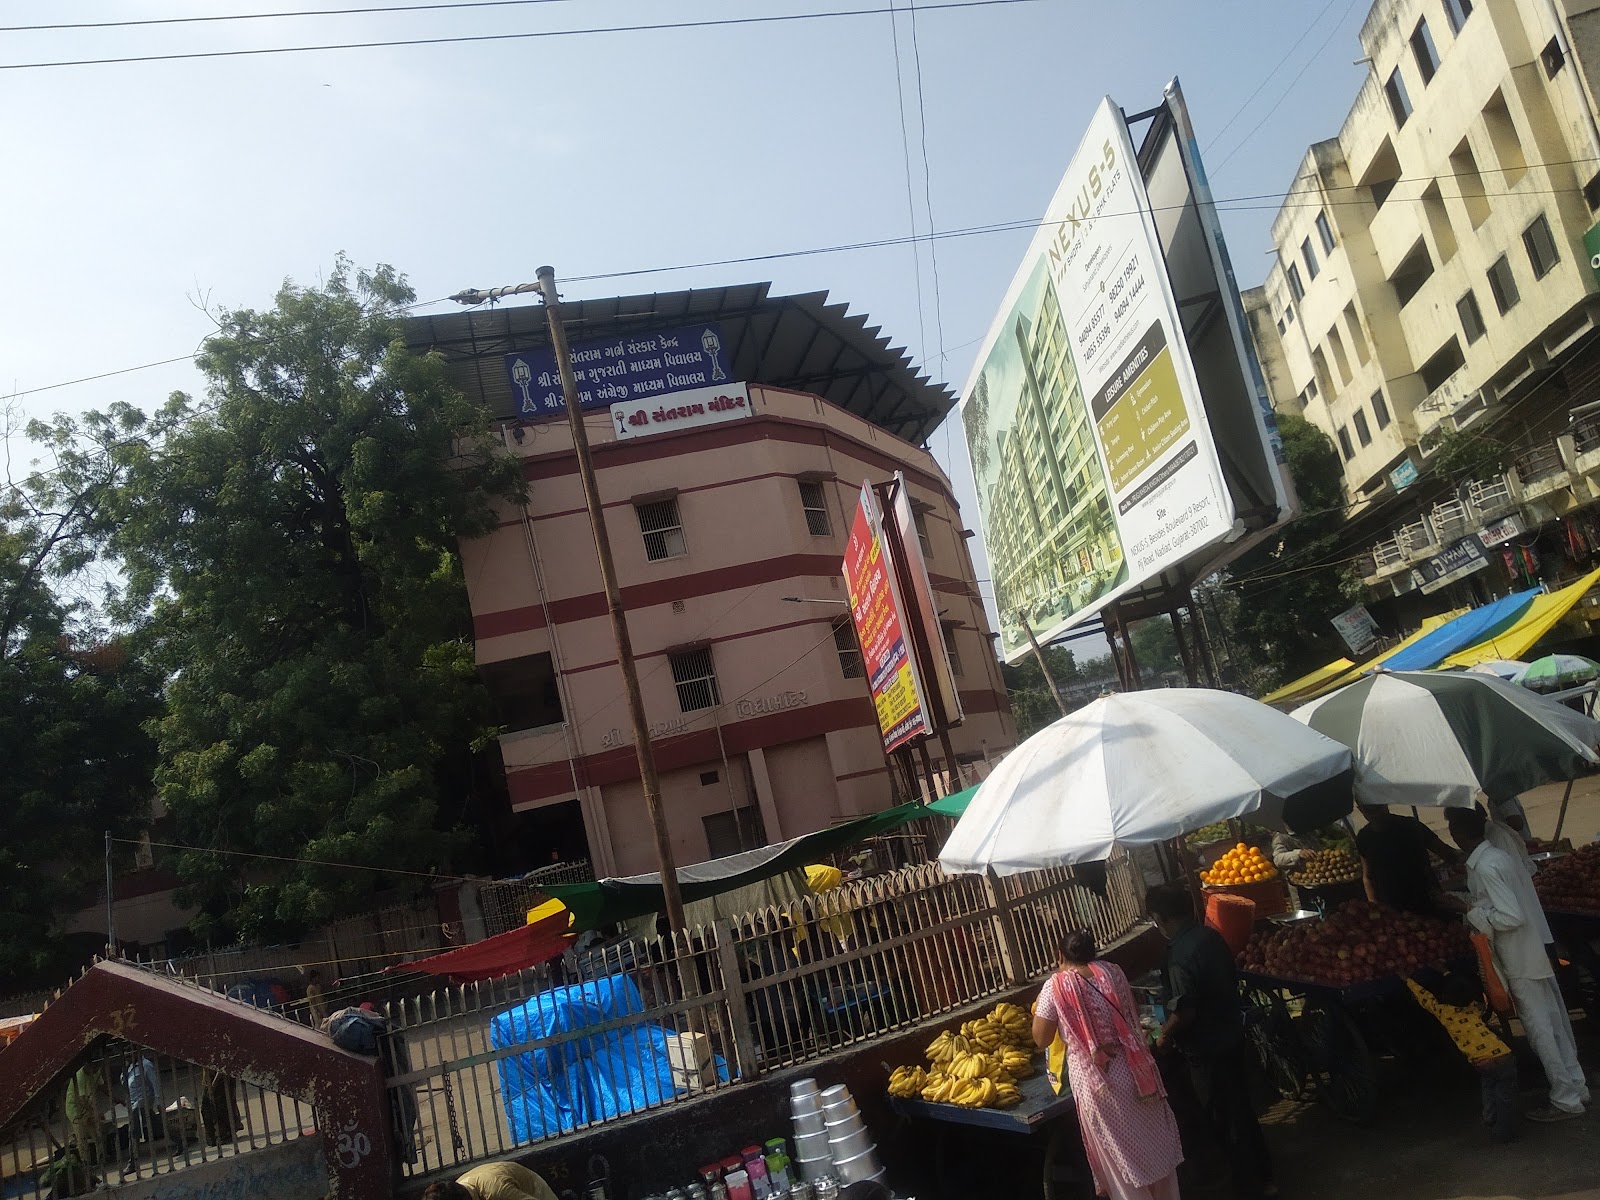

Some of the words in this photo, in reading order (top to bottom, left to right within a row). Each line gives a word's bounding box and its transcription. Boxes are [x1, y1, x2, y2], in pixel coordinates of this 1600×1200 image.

[1066, 239, 1082, 266] SHOPS
[1096, 197, 1107, 216] BHK
[1107, 169, 1121, 197] FLATS
[1084, 244, 1102, 272] Developers
[1109, 277, 1124, 304] 98250
[1123, 254, 1139, 279] 19921
[1114, 300, 1129, 323] 94094
[1129, 274, 1146, 302] 14444
[604, 340, 625, 359] ગર્ભ
[627, 338, 657, 354] સંસ્કાર
[660, 334, 679, 351] કેન્દ્ર
[1078, 324, 1092, 347] 94094
[538, 371, 552, 387] શ્રી
[588, 360, 628, 383] ગુજરાતી
[630, 356, 662, 373] માધ્યમ
[663, 350, 703, 368] વિદ્યાલય
[1104, 375, 1123, 403] LEISURE
[1122, 346, 1149, 382] AMENITIES
[544, 392, 559, 408] શ્રી
[596, 383, 629, 400] અંગ્રેજી
[633, 376, 666, 394] માધ્યમ
[667, 370, 706, 388] વિદ્યાલય
[628, 409, 649, 427] શ્રી
[652, 403, 705, 423] સંતરામ
[708, 395, 746, 412] મંદિર
[1148, 527, 1166, 545] Besides
[1165, 512, 1189, 536] Boulevard
[1156, 507, 1167, 521] Site
[601, 728, 625, 748] શ્રી
